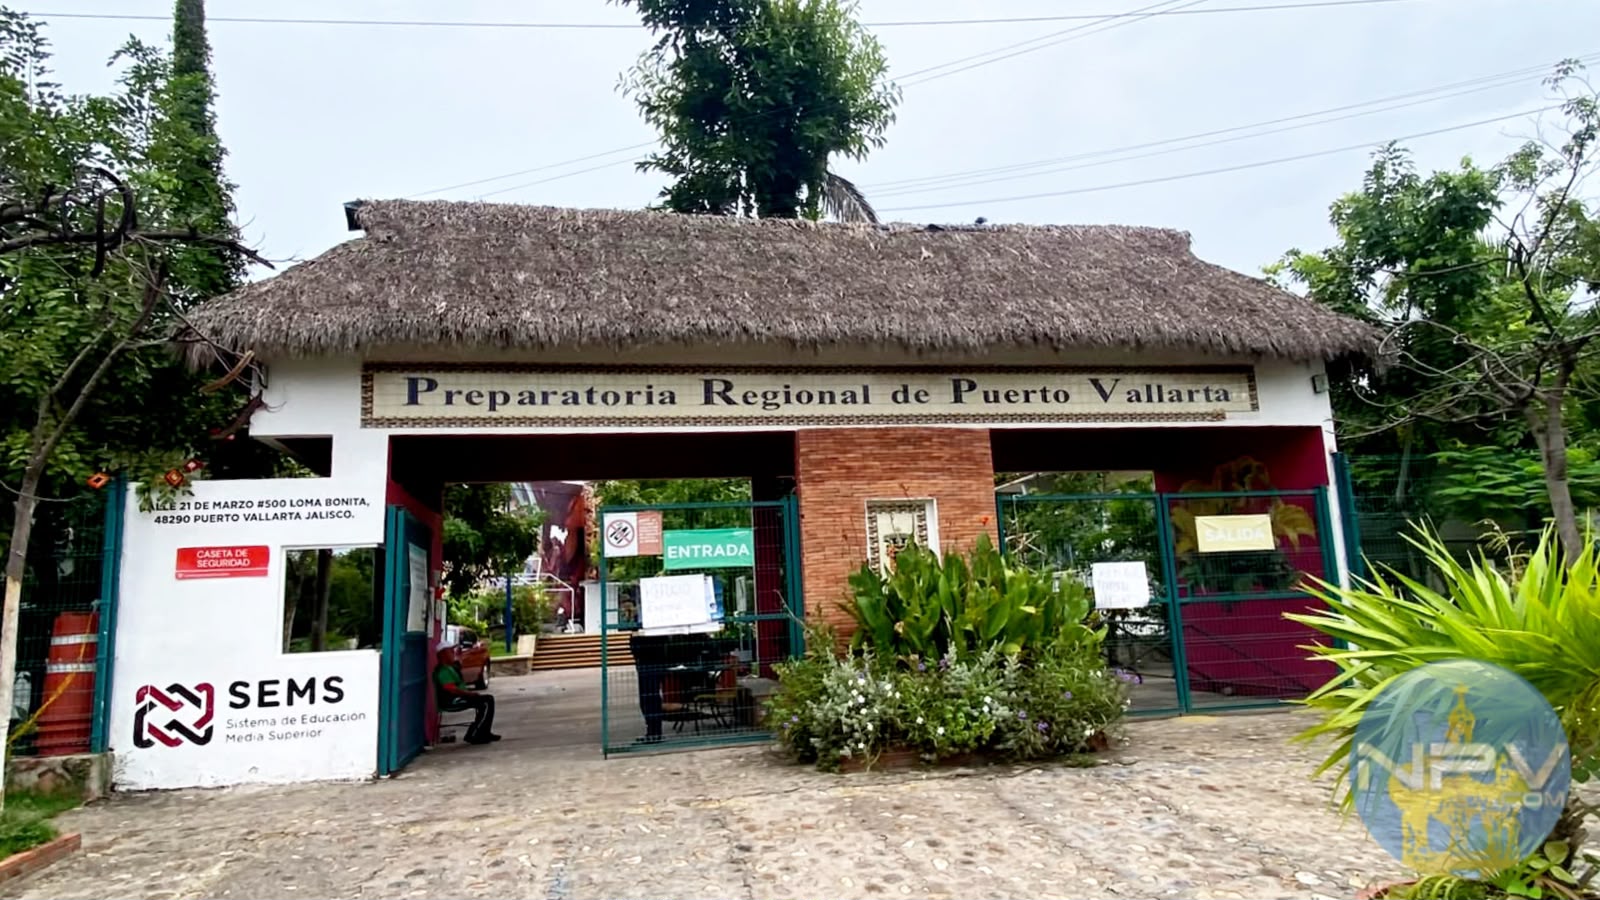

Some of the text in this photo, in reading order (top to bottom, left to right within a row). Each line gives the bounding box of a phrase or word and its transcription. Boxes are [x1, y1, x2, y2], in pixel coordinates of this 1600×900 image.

[402, 376, 1231, 412] Preparatoria Regional de Puerto Vallarta
[179, 501, 191, 511] 21
[194, 501, 209, 511] DE
[212, 499, 254, 510] MARZO
[257, 498, 287, 509] #500
[289, 498, 322, 508] LOMA
[325, 496, 370, 508] BONITA,
[154, 510, 355, 524] 48290 PUERTO VALLARTA JALISCO.
[1204, 527, 1265, 542] SALIDA
[196, 549, 248, 558] CASETA DE
[667, 543, 750, 559] ENTRADA
[196, 558, 250, 568] SEGURIDAD
[228, 675, 345, 709] SEMS
[225, 718, 277, 729] Sistema
[280, 715, 297, 726] de
[225, 729, 322, 743] Media Superior
